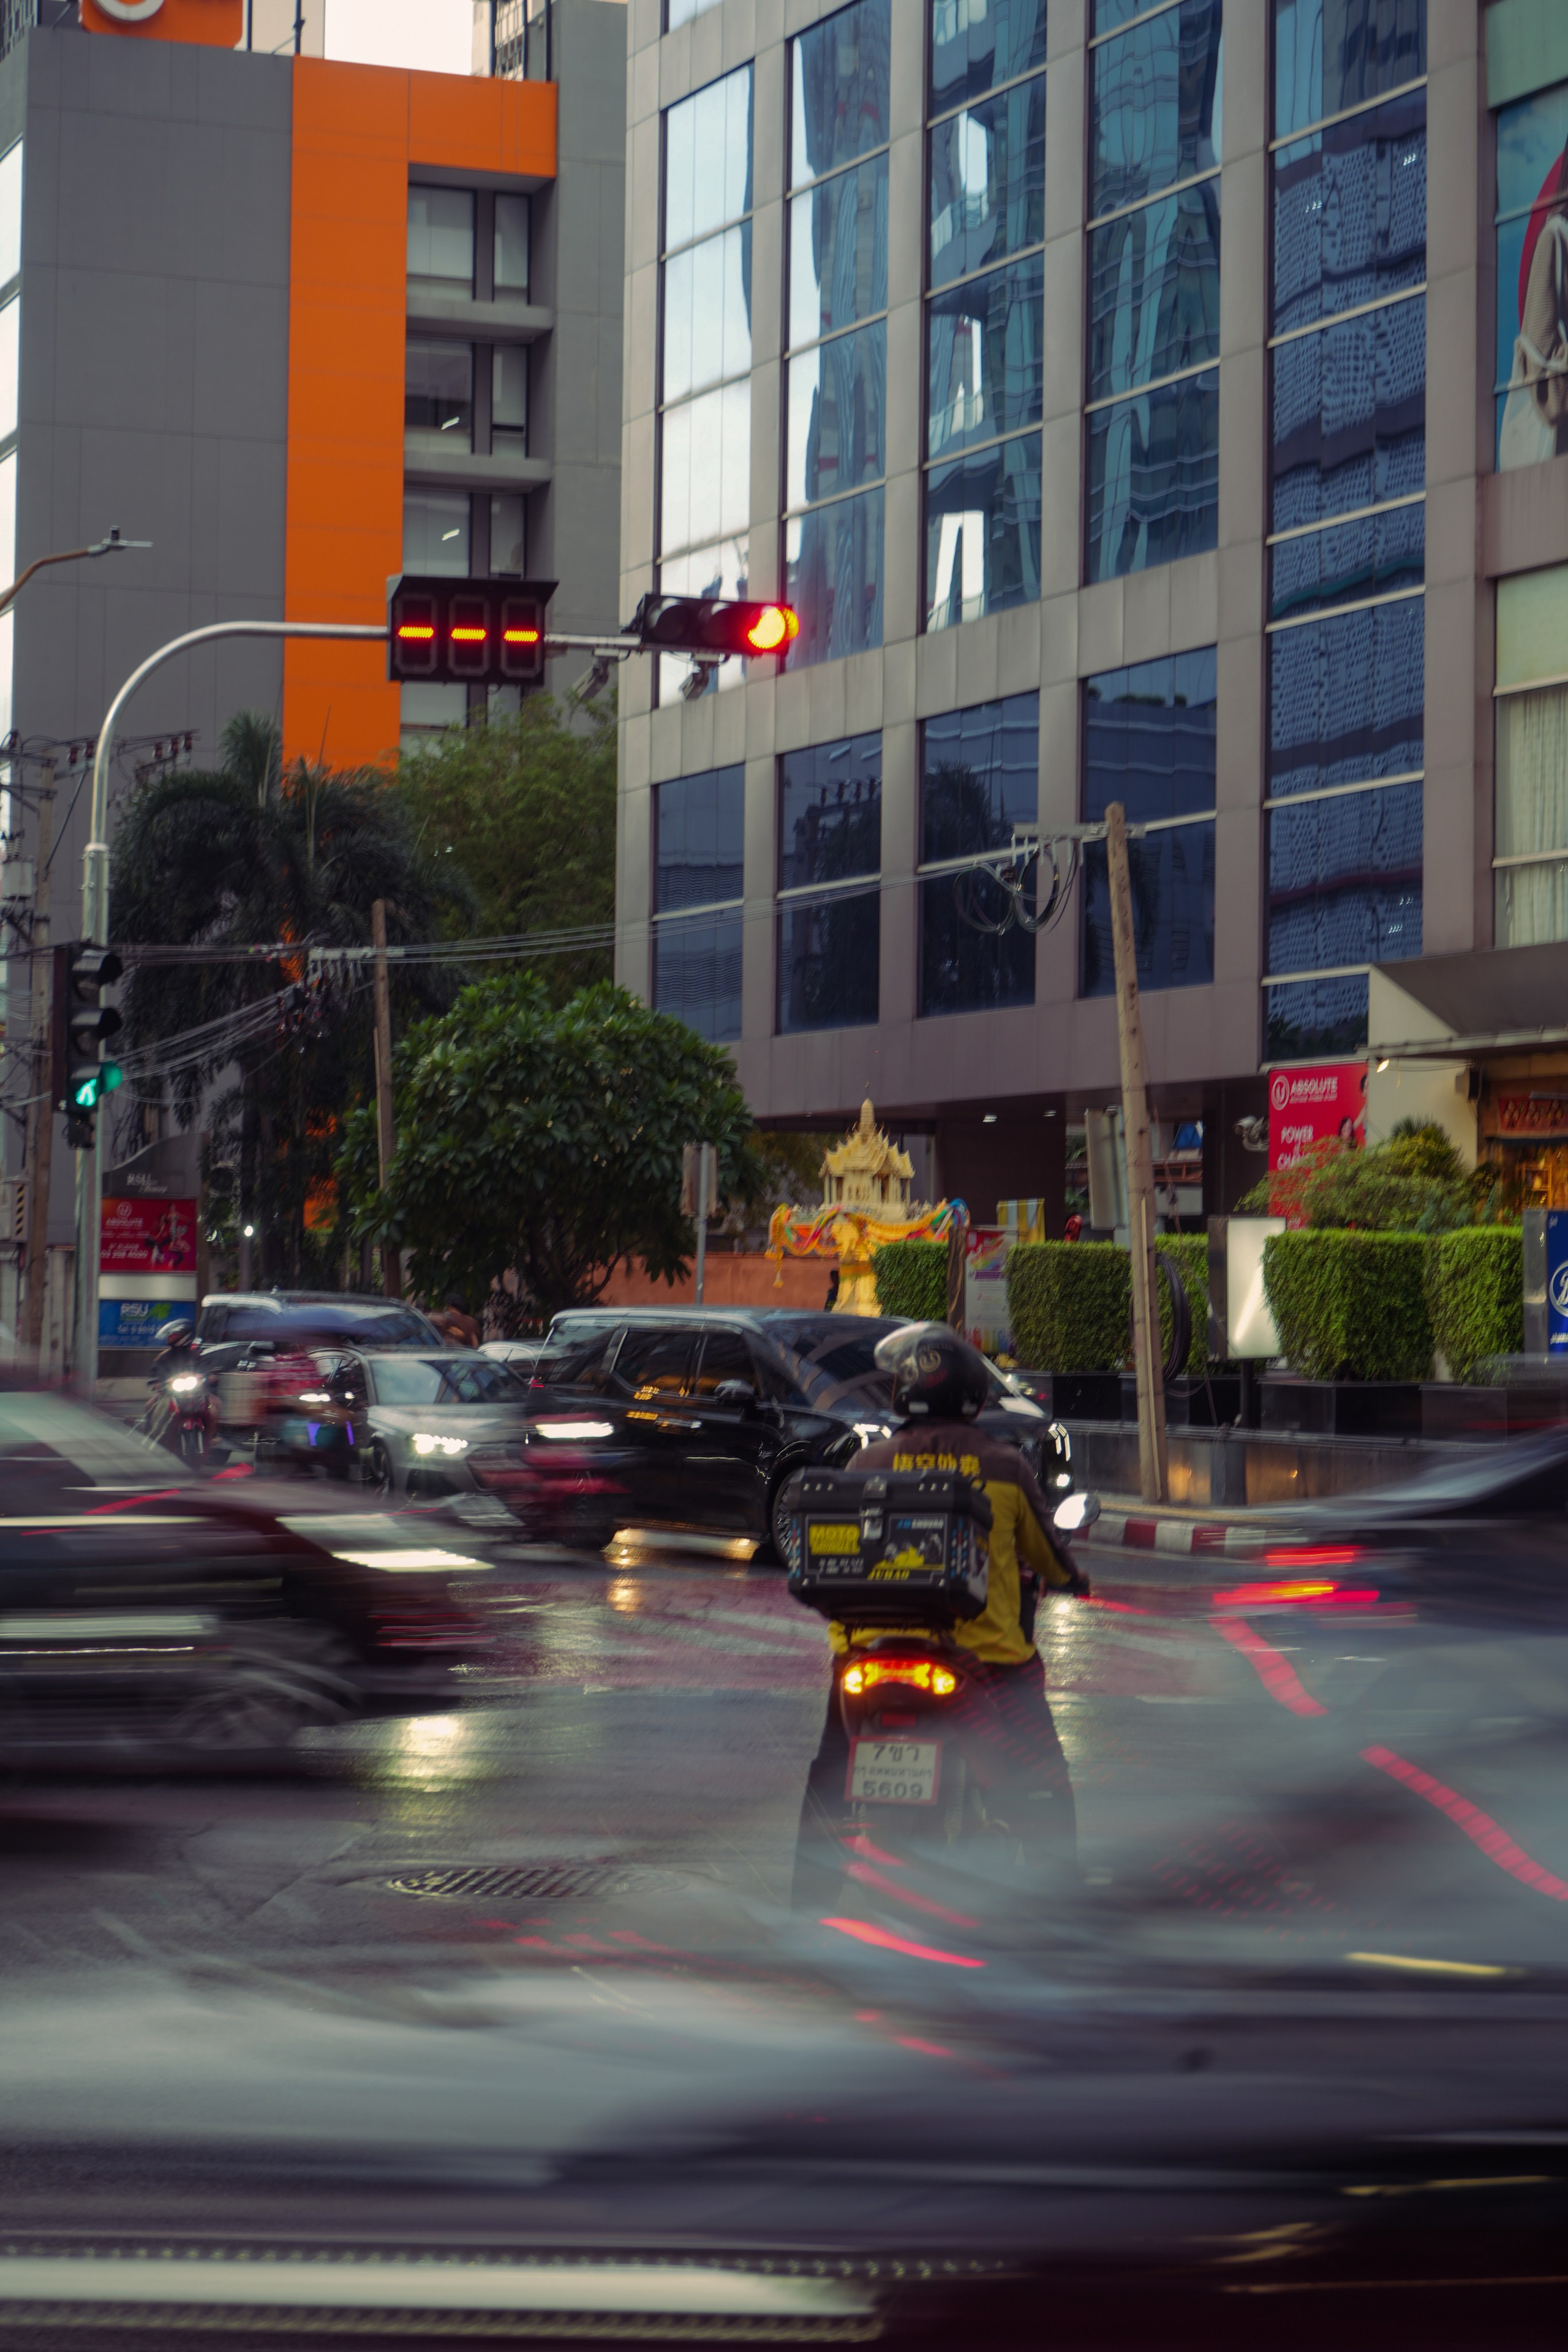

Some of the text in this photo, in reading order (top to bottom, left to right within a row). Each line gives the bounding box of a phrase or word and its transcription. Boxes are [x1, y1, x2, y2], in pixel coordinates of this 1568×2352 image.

[1290, 1076, 1338, 1096] ABSOLUTE
[1281, 1125, 1313, 1144] POWER
[106, 1217, 143, 1227] ABSOLUTE
[120, 1303, 149, 1317] RSU
[809, 1525, 860, 1540] MOTO
[810, 1539, 861, 1554] TRAVEL
[864, 1781, 923, 1799] 5609
